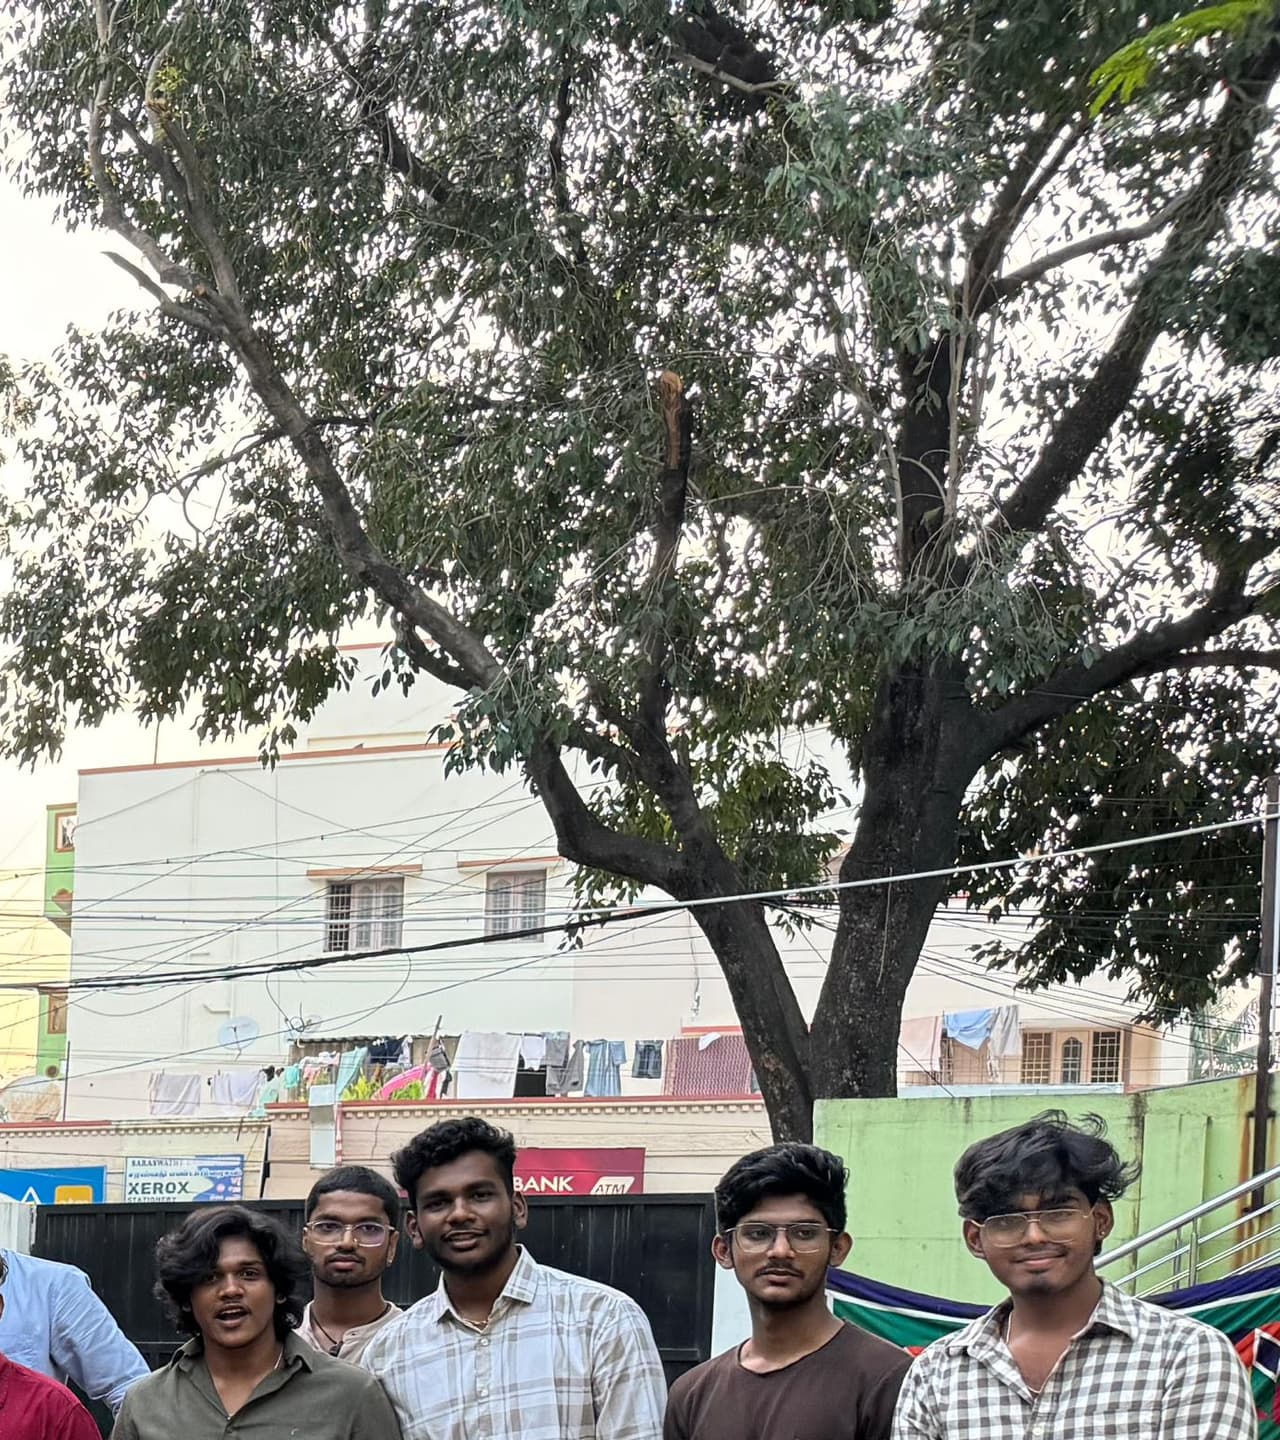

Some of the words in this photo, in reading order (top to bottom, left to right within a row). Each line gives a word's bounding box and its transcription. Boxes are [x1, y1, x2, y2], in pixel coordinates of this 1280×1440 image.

[128, 1181, 190, 1195] XEROX
[513, 1175, 575, 1193] BANK
[595, 1183, 627, 1194] ATM
